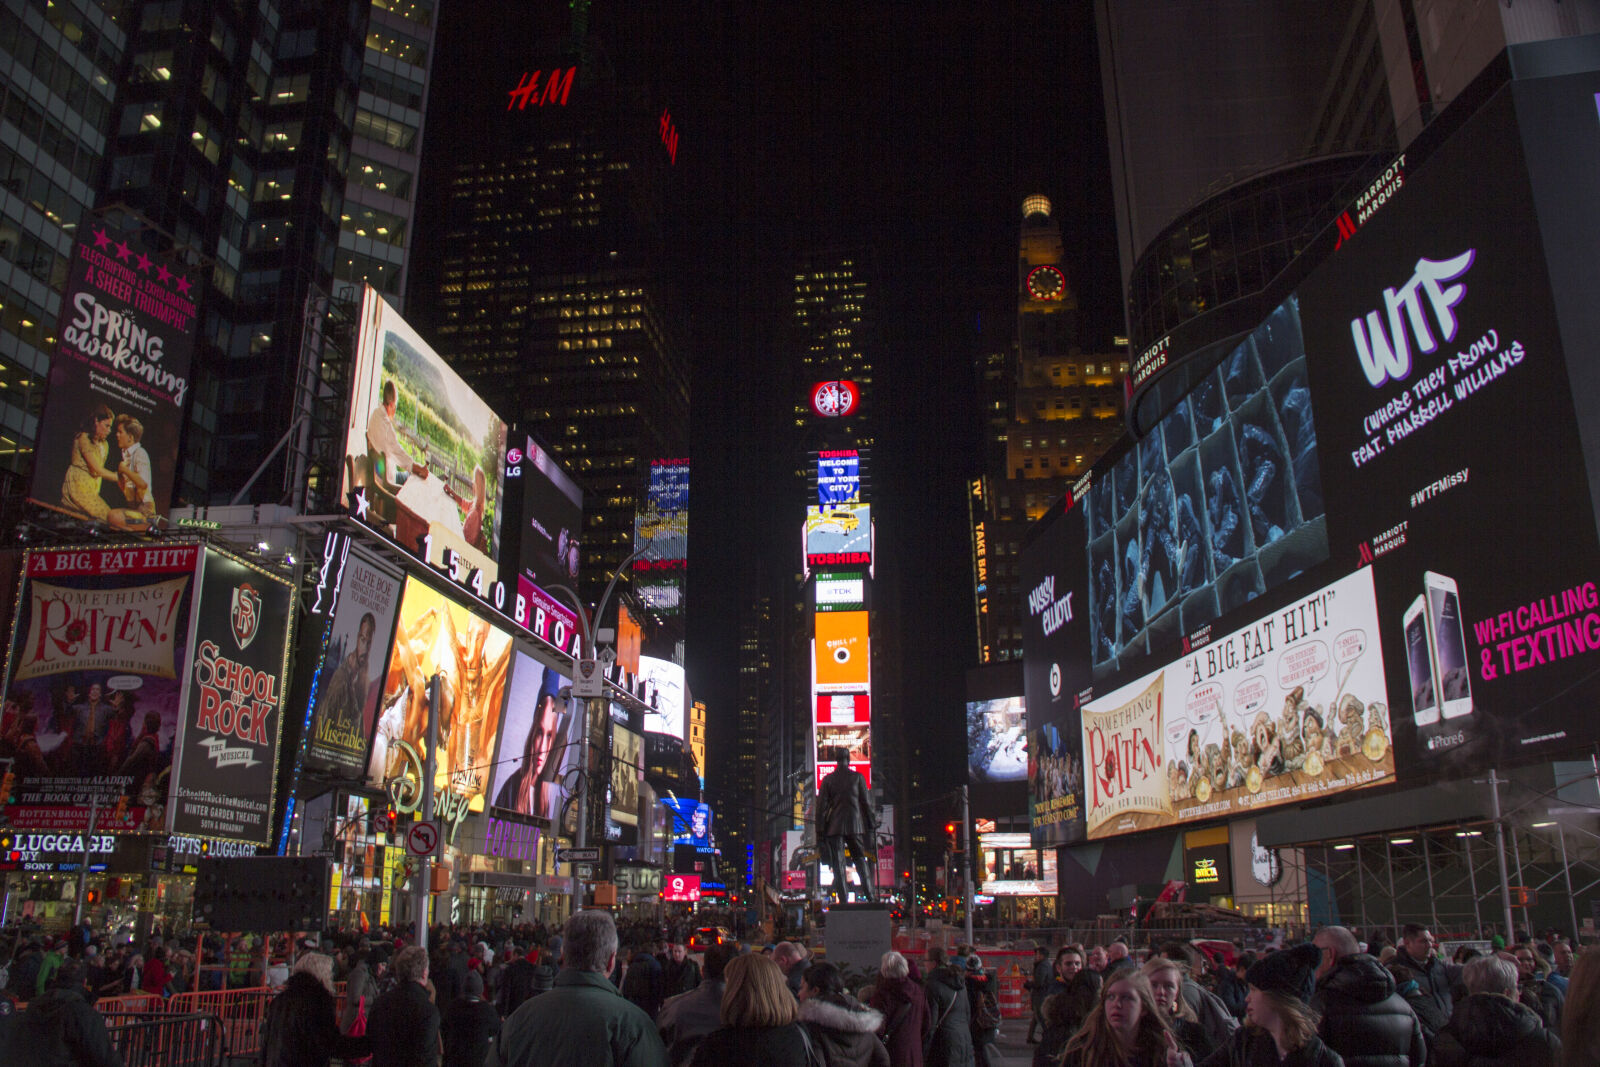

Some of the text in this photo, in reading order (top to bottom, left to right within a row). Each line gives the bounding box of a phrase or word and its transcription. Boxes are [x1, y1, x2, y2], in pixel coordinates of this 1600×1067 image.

[507, 66, 576, 111] H&M
[1356, 153, 1406, 211] MARRIOTT
[1358, 175, 1402, 225] MARQUIS
[85, 265, 94, 285] A
[95, 270, 132, 304] SHEER
[73, 291, 164, 362] SPRING
[1350, 247, 1477, 389] WTF
[1447, 328, 1500, 377] FROM)
[63, 325, 189, 407] awakening
[1453, 340, 1526, 401] WILLIAMS
[818, 449, 859, 458] TOSHIBA
[818, 458, 858, 467] WELCOME
[506, 466, 521, 477] LG
[818, 475, 860, 484] NEW YORK
[832, 467, 845, 475] TO
[829, 484, 849, 492] CITY
[1410, 467, 1469, 508] #WTFMissy
[178, 518, 219, 529] LAMAR
[1372, 520, 1408, 546] MARRIOTT
[975, 521, 986, 557] TAKE
[1374, 533, 1406, 556] MARQUIS
[100, 551, 138, 568] FAT
[807, 552, 871, 565] TOSHIBA
[352, 564, 394, 597] ALFIE BOE
[51, 587, 165, 606] SOMETHING
[532, 591, 551, 615] Genuine
[1028, 575, 1056, 616] MISSY
[423, 532, 640, 699] 1540 BROAWAY
[1473, 581, 1600, 646] WI-FI CALLING
[24, 588, 181, 668] ROTTEN!
[1241, 617, 1275, 664] FAT
[1480, 612, 1600, 681] & TEXTING
[194, 639, 279, 707] SCHOOL
[231, 690, 245, 707] OF
[196, 684, 272, 747] ROCK
[336, 709, 351, 729] Les
[1093, 693, 1152, 731] SOMETHING
[314, 715, 367, 752] Misérables
[210, 743, 224, 752] THE
[219, 750, 250, 762] MUSICAL
[1085, 691, 1162, 817] ROTTEN!
[90, 775, 135, 785] ALADDIN
[21, 792, 42, 802] THE
[43, 792, 73, 803] BOOK
[72, 792, 86, 803] OF
[184, 802, 261, 825] WINTER GARDEN THEATRE
[219, 821, 245, 833] BROADWAY
[484, 817, 542, 861] FOREVER
[13, 834, 116, 853] LUGGAGE
[20, 850, 39, 861] NY
[167, 835, 201, 855] GIFTS
[24, 862, 54, 871] SONY
